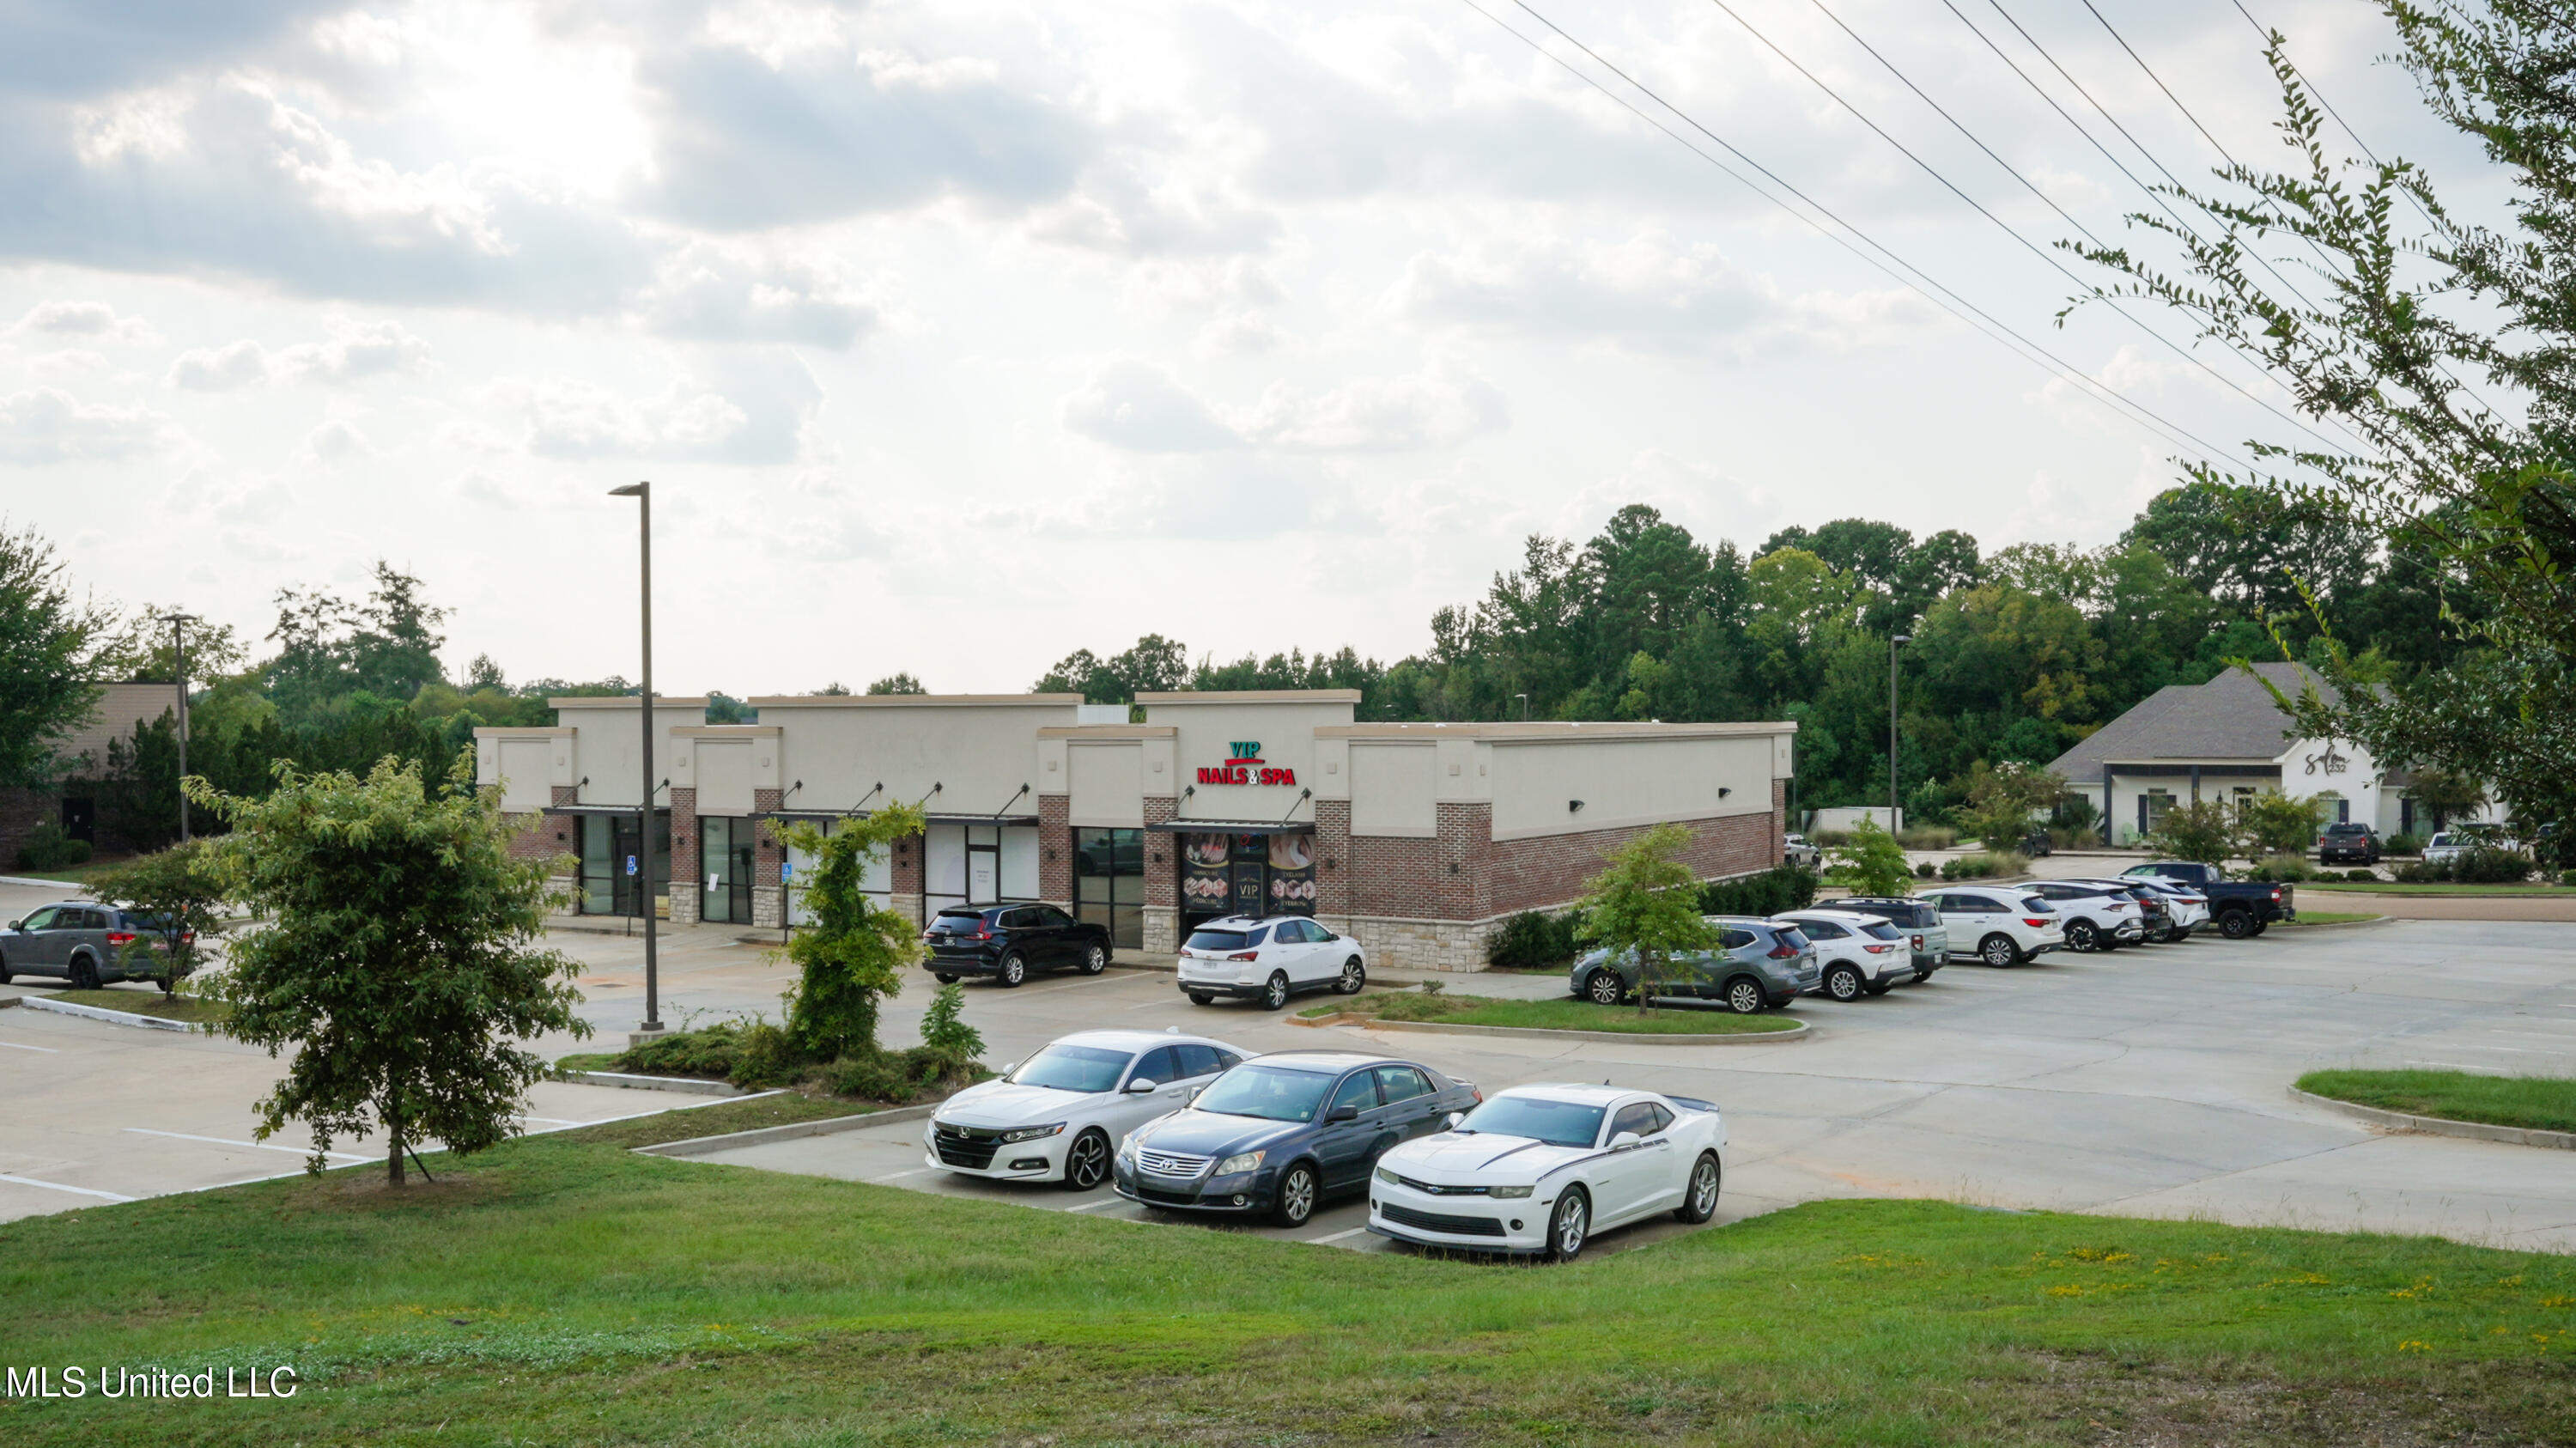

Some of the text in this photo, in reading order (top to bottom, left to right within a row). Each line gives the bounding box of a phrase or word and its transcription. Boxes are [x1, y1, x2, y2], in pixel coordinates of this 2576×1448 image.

[1230, 741, 1261, 758] VIP
[2328, 764, 2347, 773] 232
[1197, 768, 1296, 785] NAILS & SPA
[1239, 885, 1258, 895] VIP
